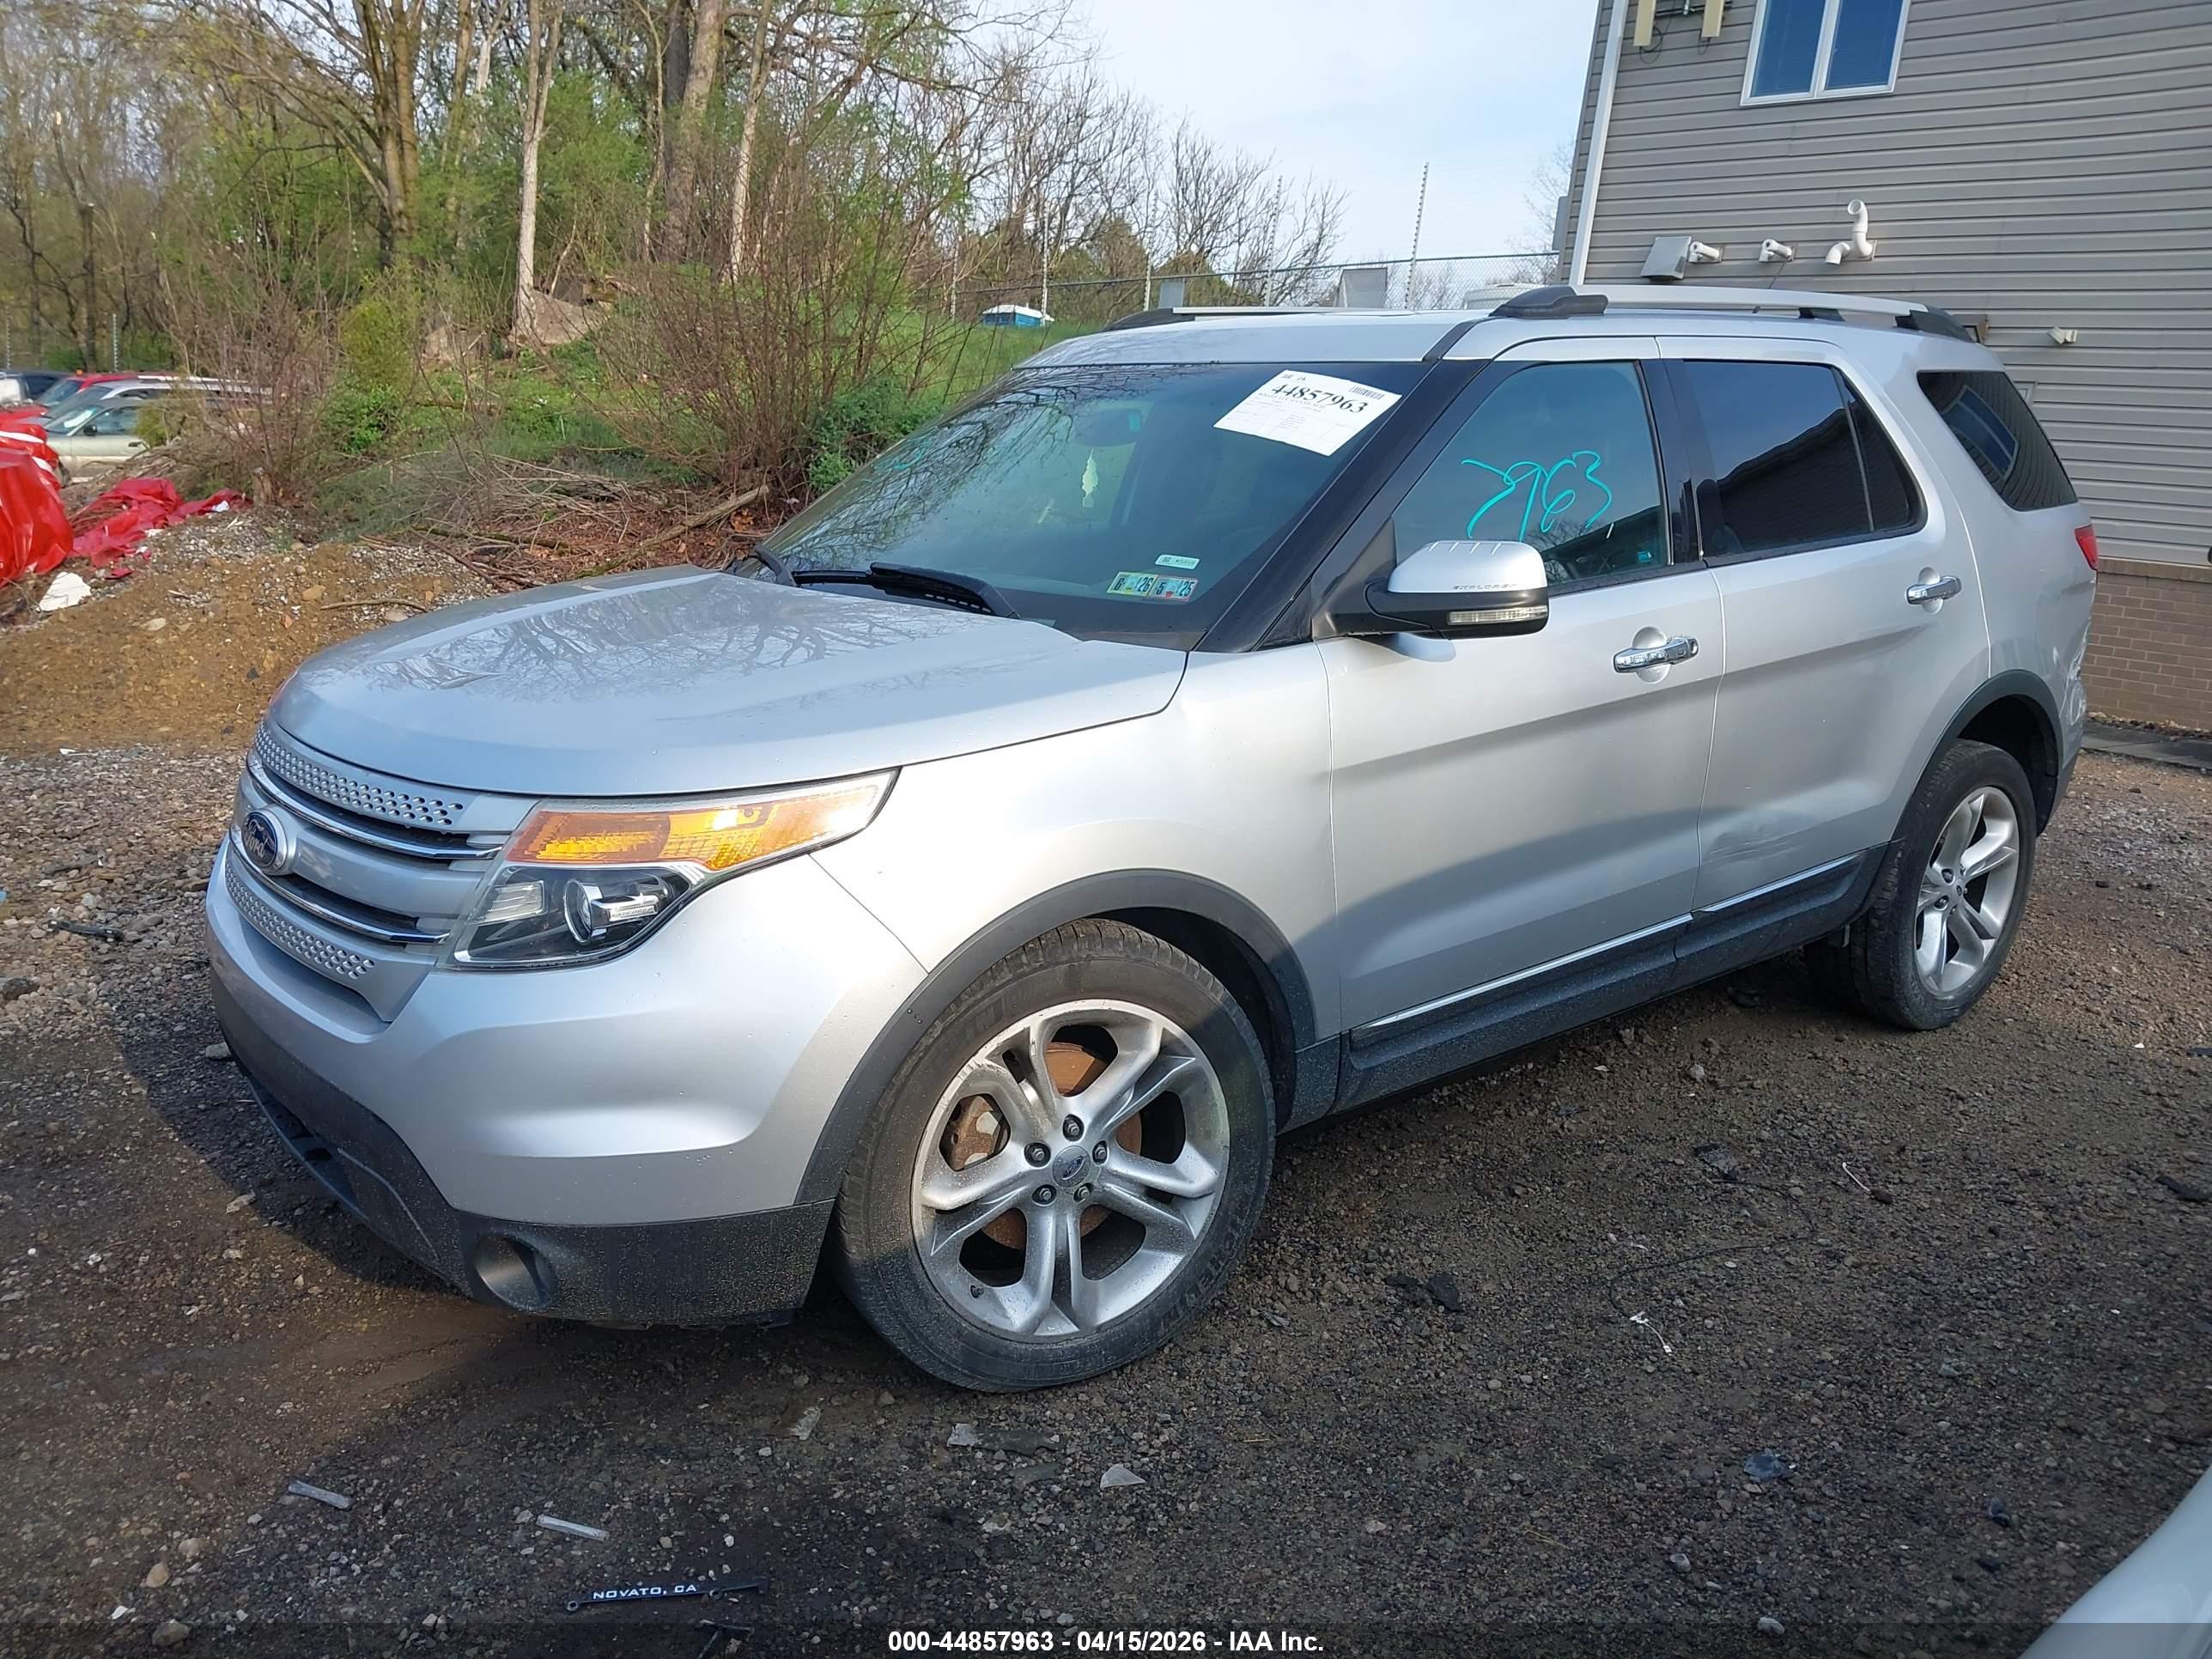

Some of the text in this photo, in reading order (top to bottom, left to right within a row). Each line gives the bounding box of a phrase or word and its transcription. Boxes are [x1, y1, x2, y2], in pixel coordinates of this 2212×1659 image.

[1271, 383, 1369, 414] 44857963
[1114, 577, 1125, 591] 6
[1156, 581, 1167, 595] 5
[244, 819, 269, 858] Ford
[592, 1583, 698, 1600] NOVATO, CA
